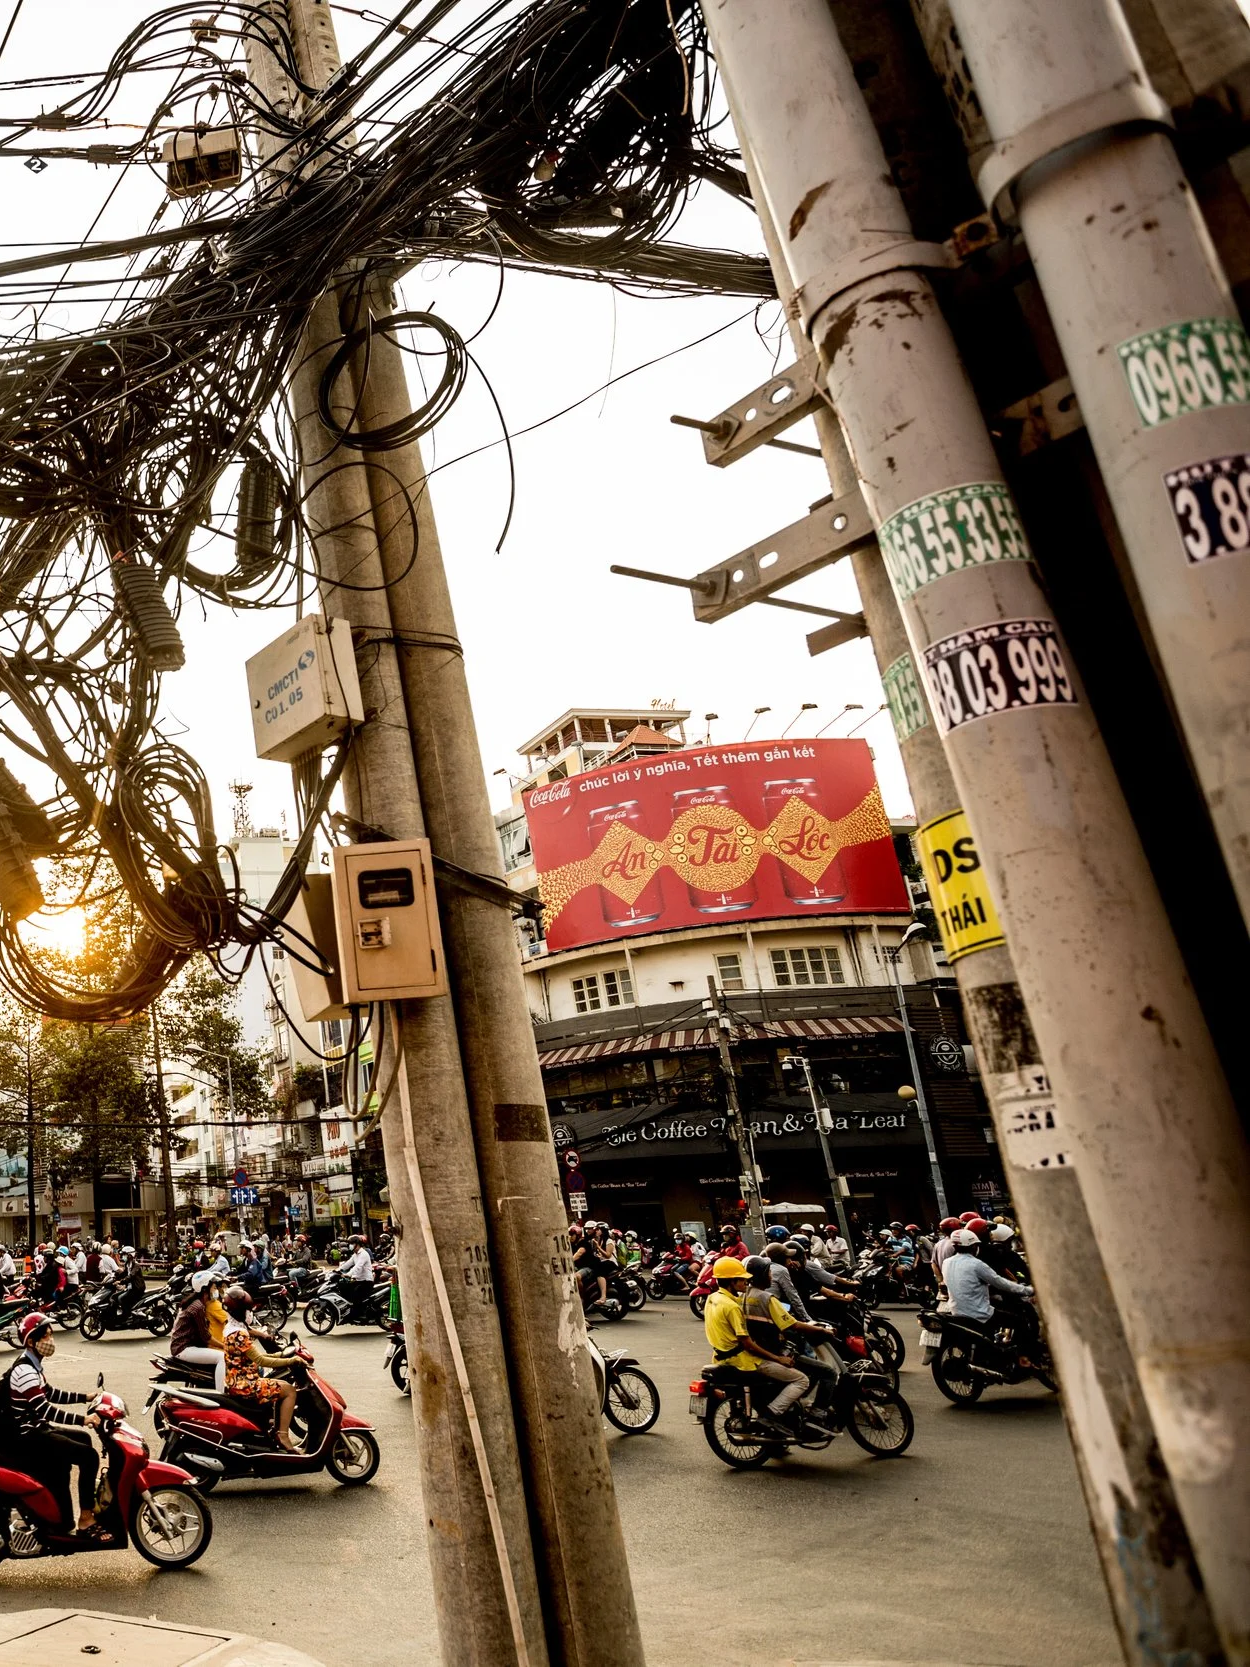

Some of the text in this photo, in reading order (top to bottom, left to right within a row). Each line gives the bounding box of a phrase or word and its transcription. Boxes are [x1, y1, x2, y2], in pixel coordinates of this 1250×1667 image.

[267, 668, 299, 700] CMCTI
[579, 777, 610, 793] chúc
[613, 772, 630, 784] lời
[633, 767, 642, 781] ý
[646, 760, 691, 777] nghĩa,
[693, 753, 719, 768] Tết
[722, 751, 760, 765] thêm
[793, 745, 816, 758] kết
[602, 841, 647, 880] An
[688, 824, 741, 866] Tài
[641, 1120, 708, 1141] Coffee
[782, 1114, 805, 1132] &
